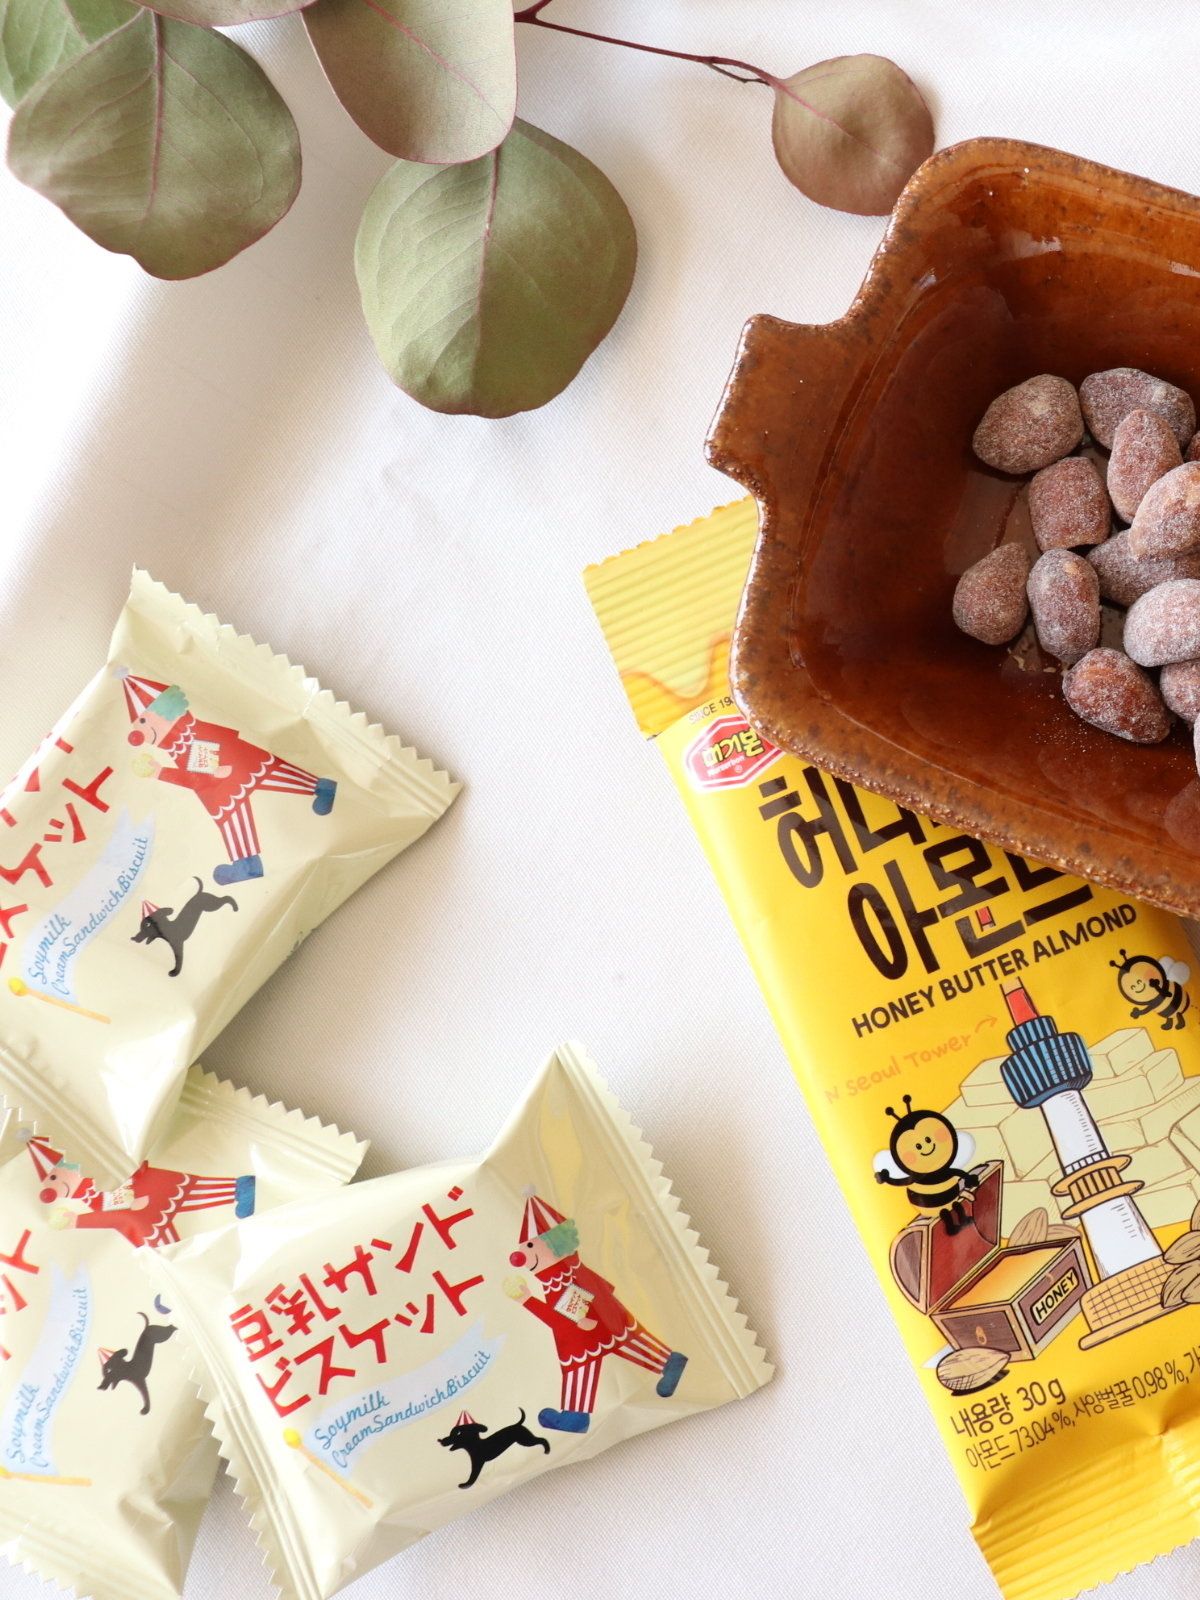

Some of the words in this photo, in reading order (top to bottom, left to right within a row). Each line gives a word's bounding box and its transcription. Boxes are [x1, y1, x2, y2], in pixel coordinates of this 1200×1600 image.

[758, 766, 928, 889] 허니
[28, 912, 73, 986] Soymilk
[851, 985, 936, 1038] HONEY
[938, 948, 1030, 1002] BUTTER
[1032, 903, 1138, 963] ALMOND
[229, 1185, 475, 1363] 豆乳サンド
[1035, 1271, 1075, 1320] HONEY
[255, 1269, 486, 1419] ビスケット
[6, 1383, 41, 1464] Soymilk
[314, 1389, 391, 1451] Soymilk
[951, 1393, 1012, 1438] 내용량
[965, 1433, 1016, 1473] 아몬드
